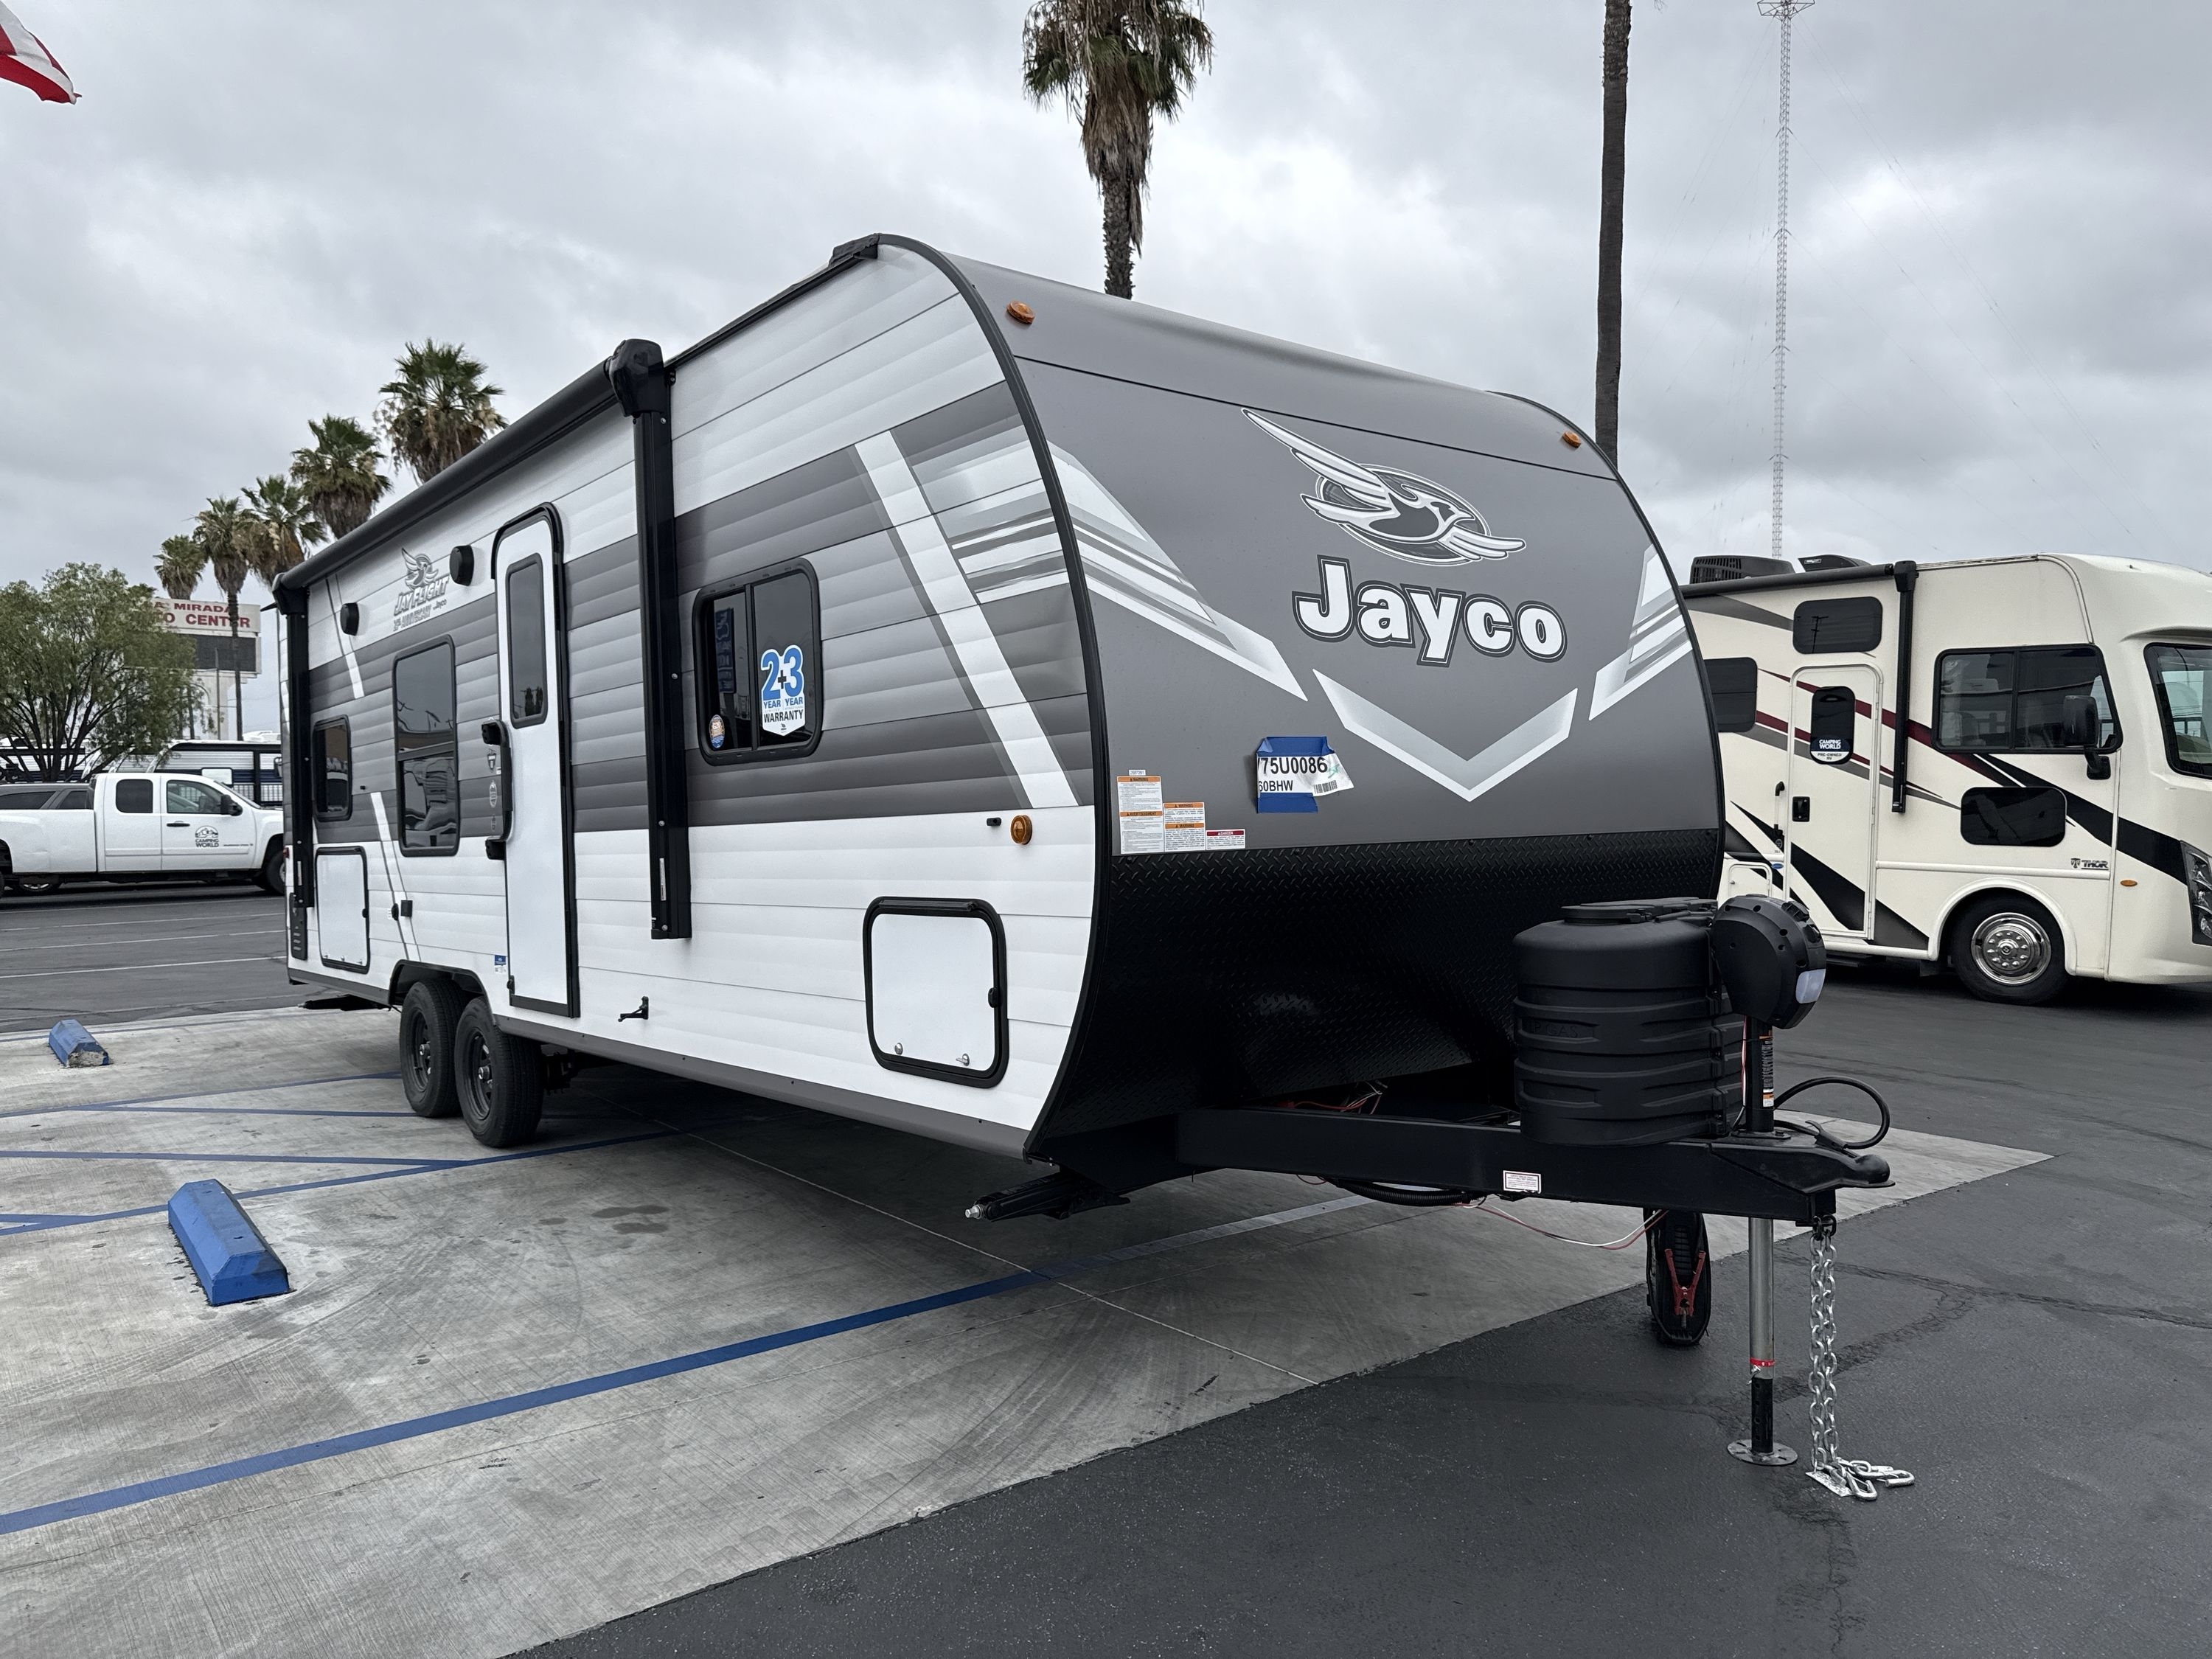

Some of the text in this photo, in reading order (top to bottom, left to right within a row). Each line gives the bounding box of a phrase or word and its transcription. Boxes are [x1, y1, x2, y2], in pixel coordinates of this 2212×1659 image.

[1292, 554, 1568, 667] Jayco
[185, 613, 251, 628] CENTR
[763, 696, 803, 709] YEAR YEAR
[763, 709, 804, 723] WARRANTY
[2081, 860, 2109, 869] THOR
[1546, 1023, 1578, 1038] GAS
